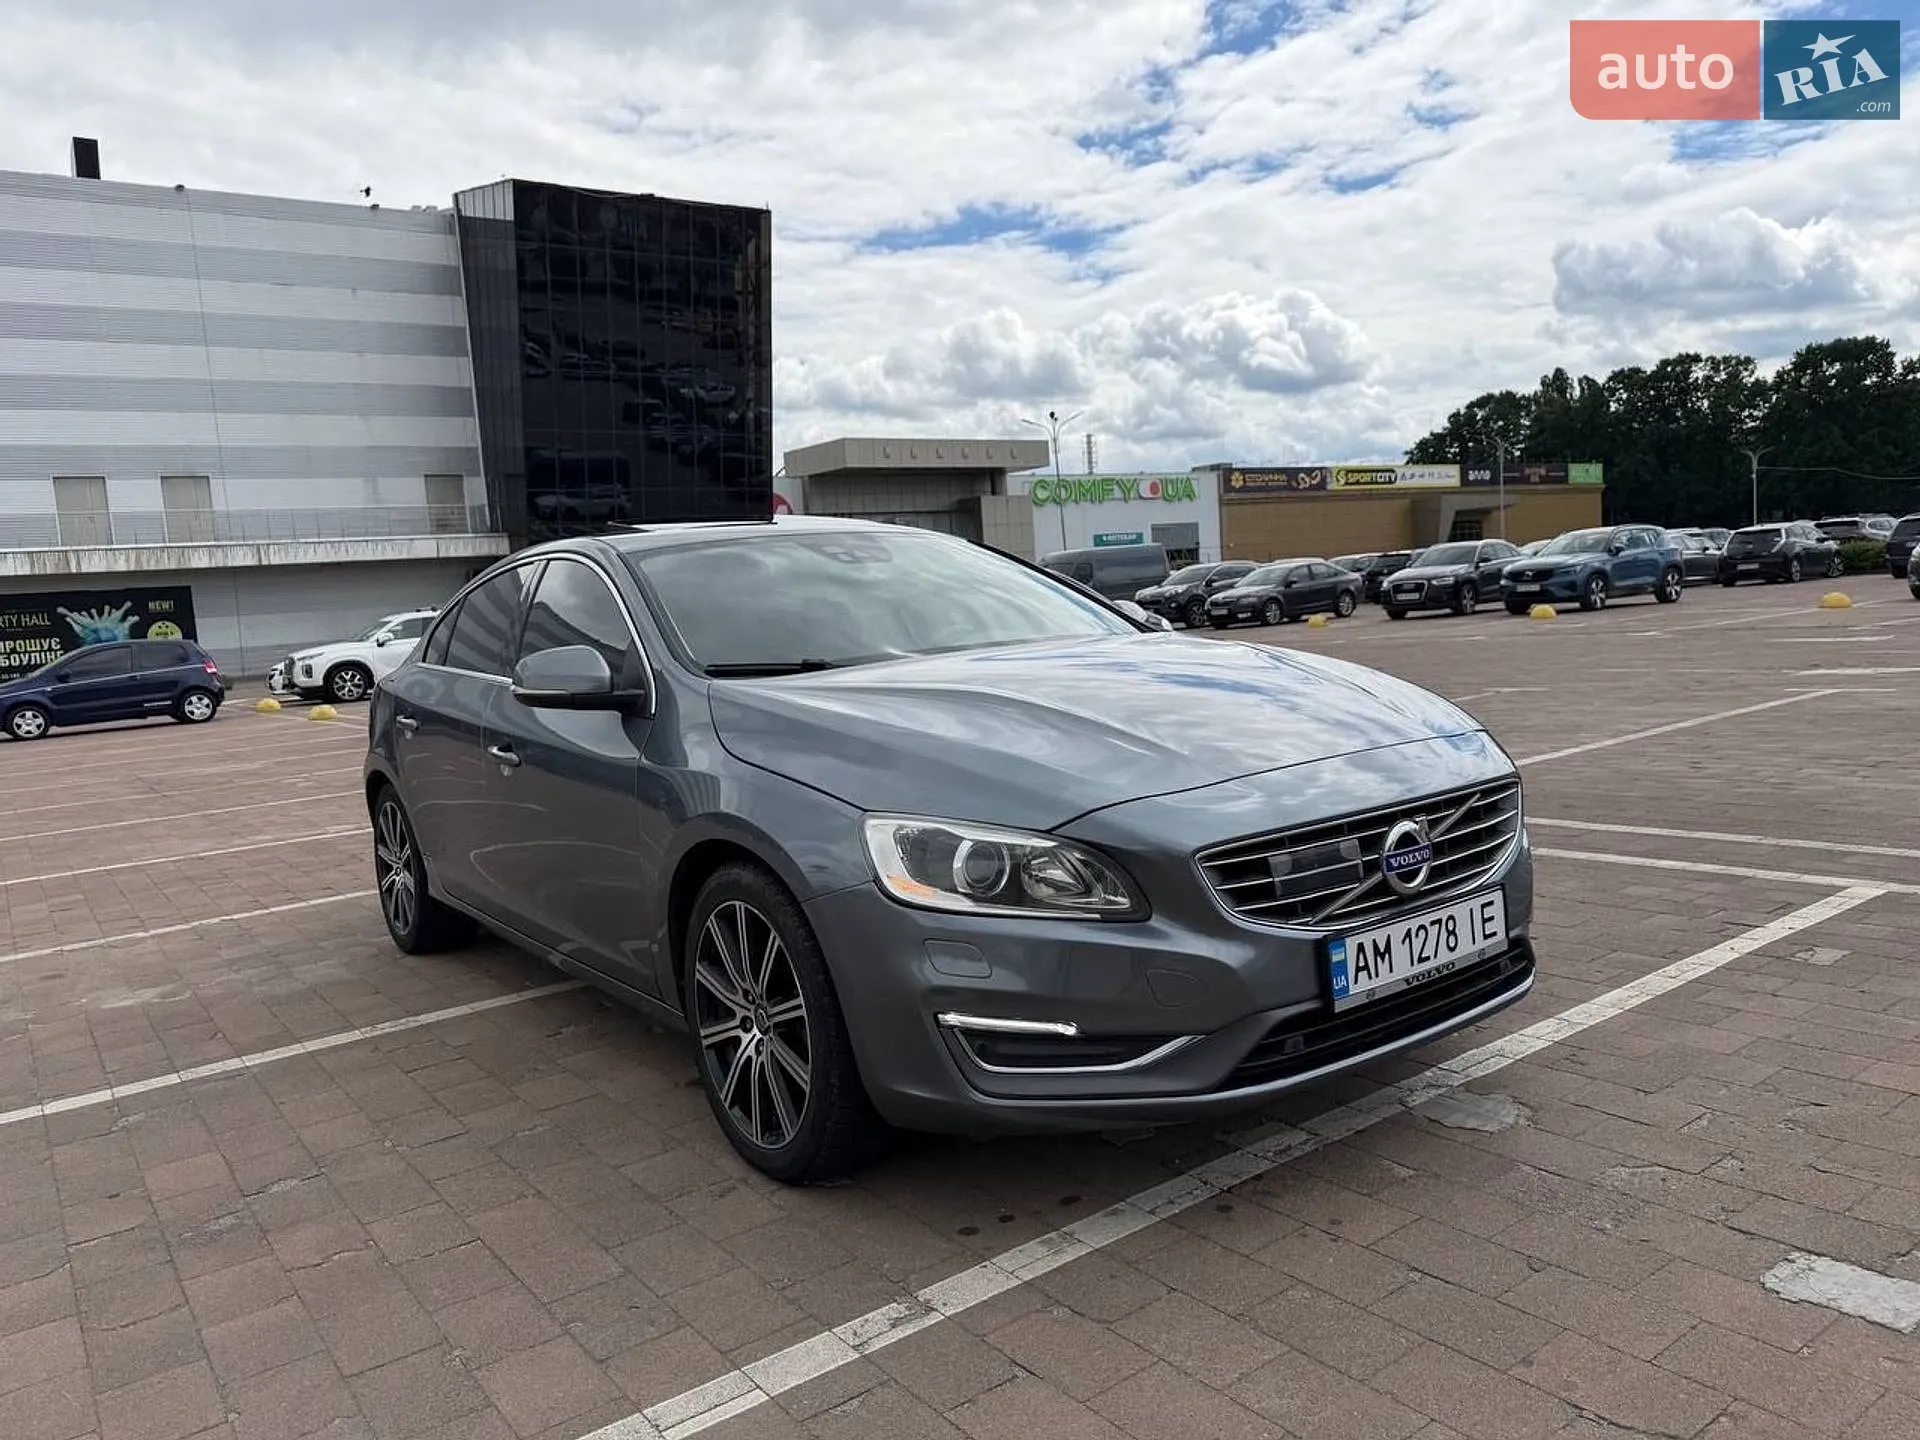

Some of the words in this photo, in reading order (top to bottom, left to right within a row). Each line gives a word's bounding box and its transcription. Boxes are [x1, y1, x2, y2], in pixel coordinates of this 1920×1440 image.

[1347, 471, 1397, 484] SPORTCITY
[20, 612, 52, 627] HALL
[1388, 849, 1430, 867] VOLVO
[1354, 934, 1393, 985] AM
[1401, 914, 1458, 967] 1278
[1469, 900, 1498, 945] IE
[1333, 974, 1347, 989] UA
[1404, 962, 1455, 986] VOLVO
